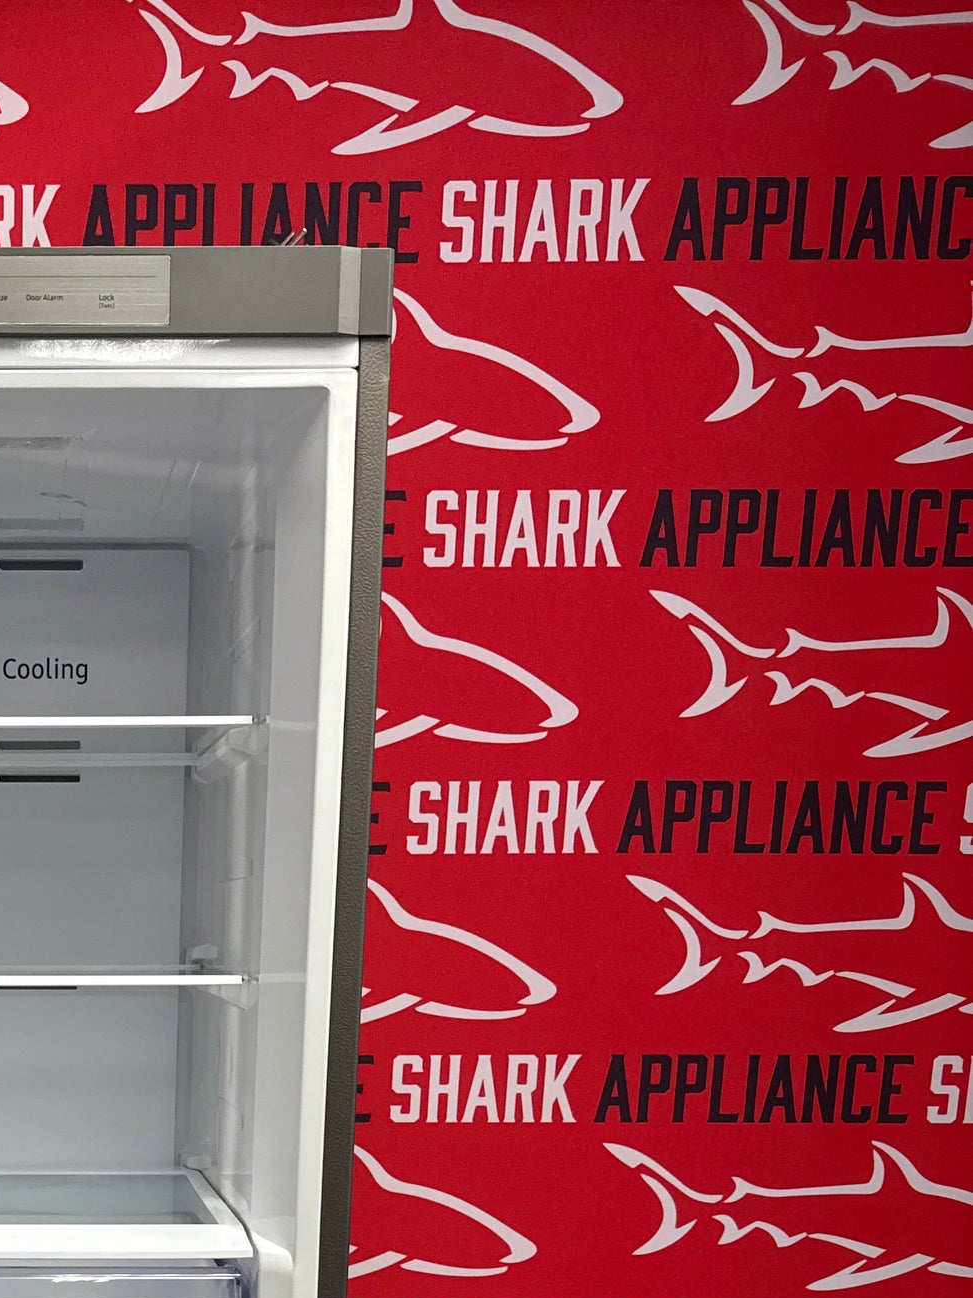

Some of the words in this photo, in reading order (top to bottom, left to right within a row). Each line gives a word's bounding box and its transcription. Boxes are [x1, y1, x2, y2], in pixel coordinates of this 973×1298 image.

[82, 180, 423, 263] APPLIANCE
[439, 178, 651, 263] SHARK
[98, 293, 115, 301] Lock
[422, 490, 627, 568] SHARK
[639, 489, 973, 568] APPLIANCE
[3, 657, 89, 685] Cooling
[406, 780, 605, 855] SHARK
[617, 780, 948, 855] APPLIANCE
[389, 1054, 582, 1123] SHARK
[593, 1054, 916, 1124] APPLIANCE
[926, 1055, 973, 1124] S
